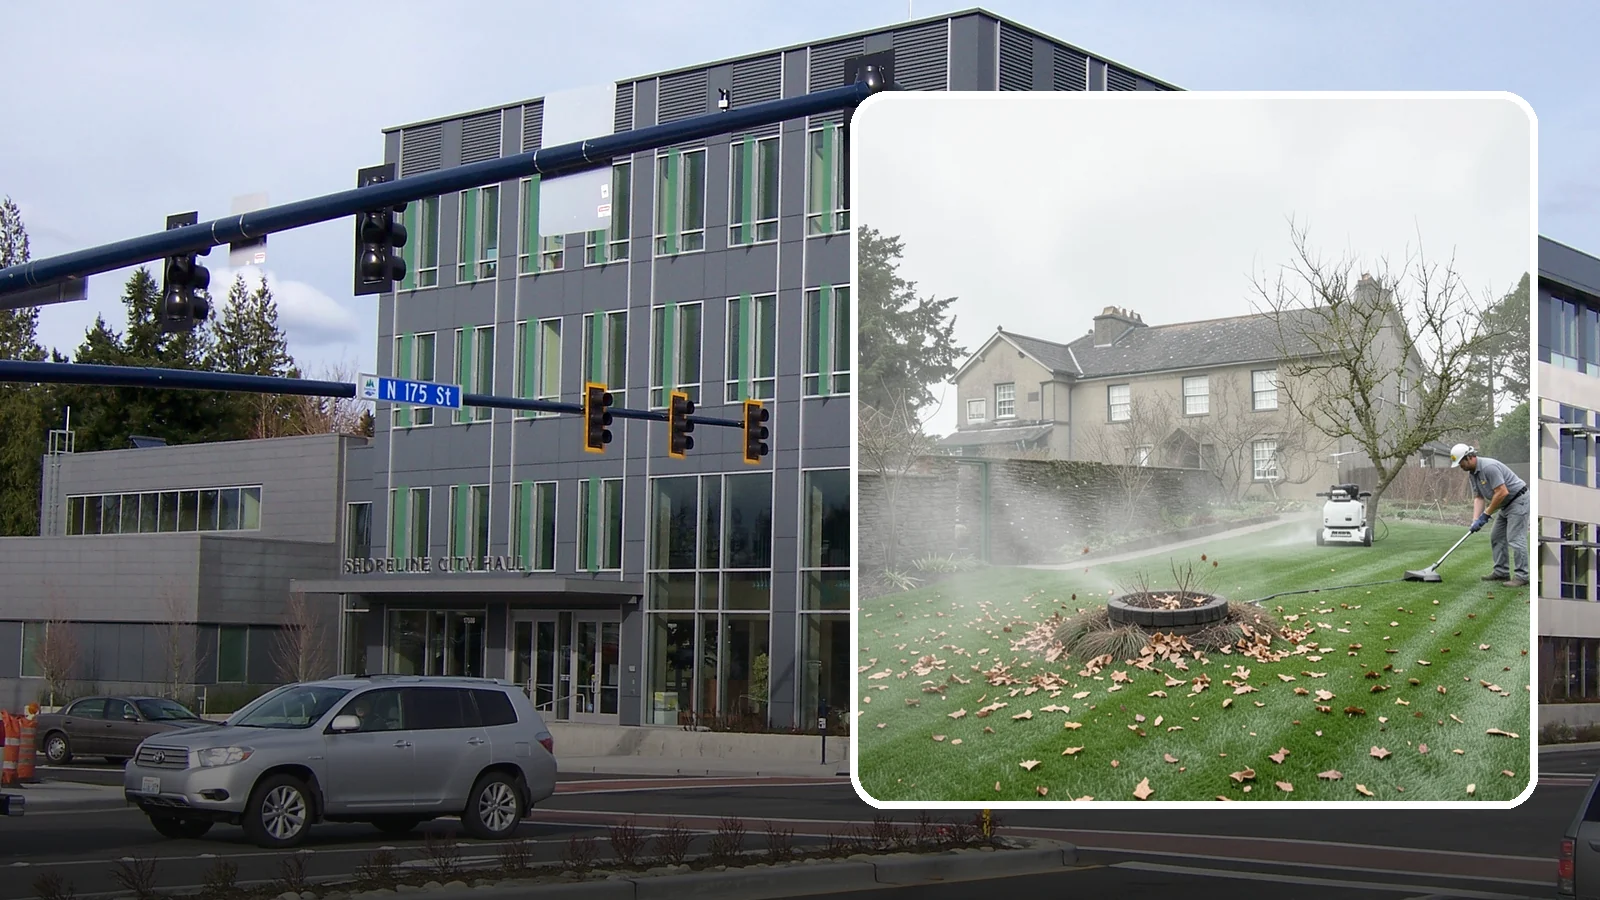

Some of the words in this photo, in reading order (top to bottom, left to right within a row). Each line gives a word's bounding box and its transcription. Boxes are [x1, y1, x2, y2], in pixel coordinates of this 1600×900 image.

[387, 380, 396, 400] N
[405, 382, 427, 403] 175
[436, 386, 451, 406] St
[344, 557, 432, 574] SHORELINE
[438, 556, 475, 572] CITY
[484, 555, 526, 571] HALL
